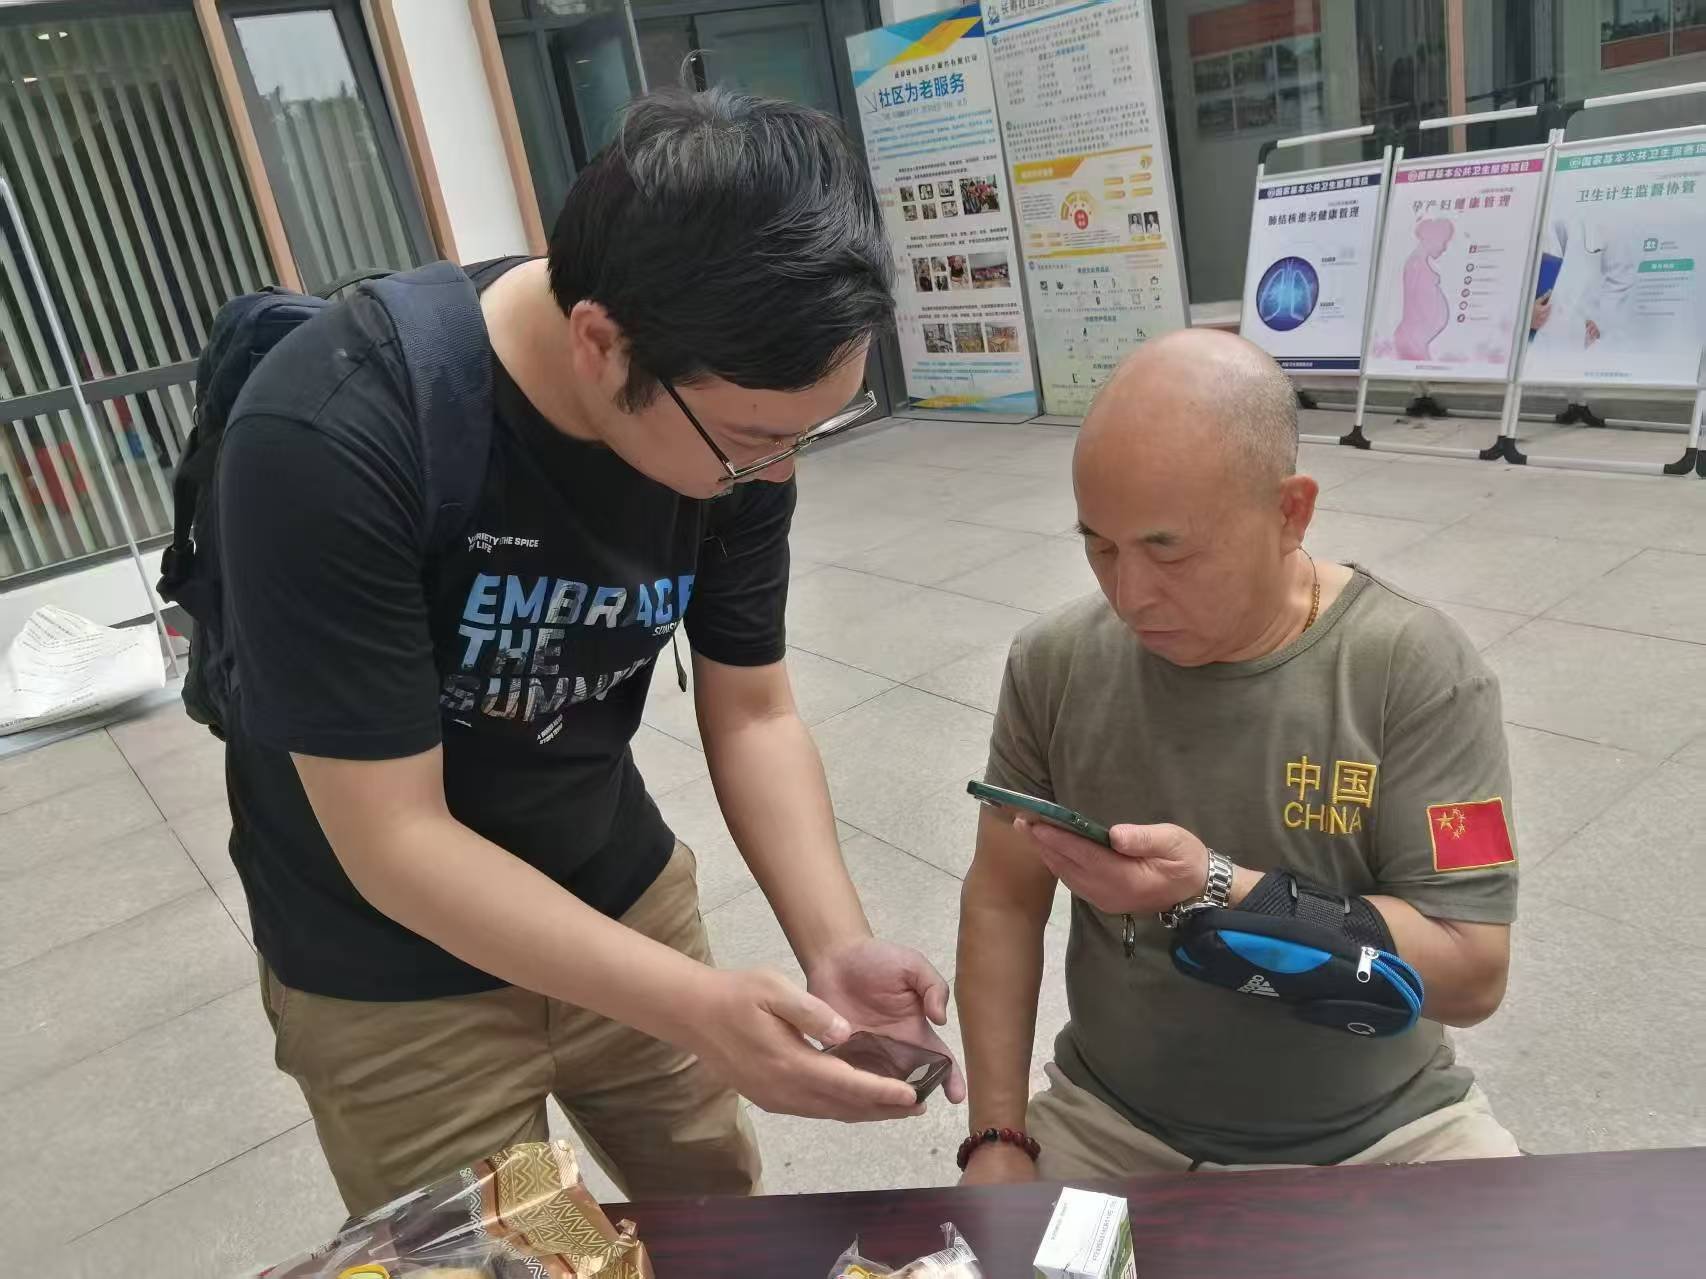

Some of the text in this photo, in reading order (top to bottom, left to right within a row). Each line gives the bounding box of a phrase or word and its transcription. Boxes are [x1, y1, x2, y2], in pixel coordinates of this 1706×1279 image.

[878, 73, 966, 109] 社区为老服务
[1417, 161, 1529, 181] 国家基本公共卫生服务项目
[1275, 176, 1369, 197] 国家基本公共卫生服务项目
[1577, 180, 1697, 202] 卫生计生监督协管
[1413, 195, 1511, 213] 孕产妇健康管理
[1268, 206, 1360, 226] 肺结核患者健康管理
[476, 541, 493, 554] LIFE
[514, 537, 540, 548] SPICE
[458, 624, 566, 675] THE
[1286, 755, 1378, 808] 中国
[1283, 801, 1364, 836] CHINA
